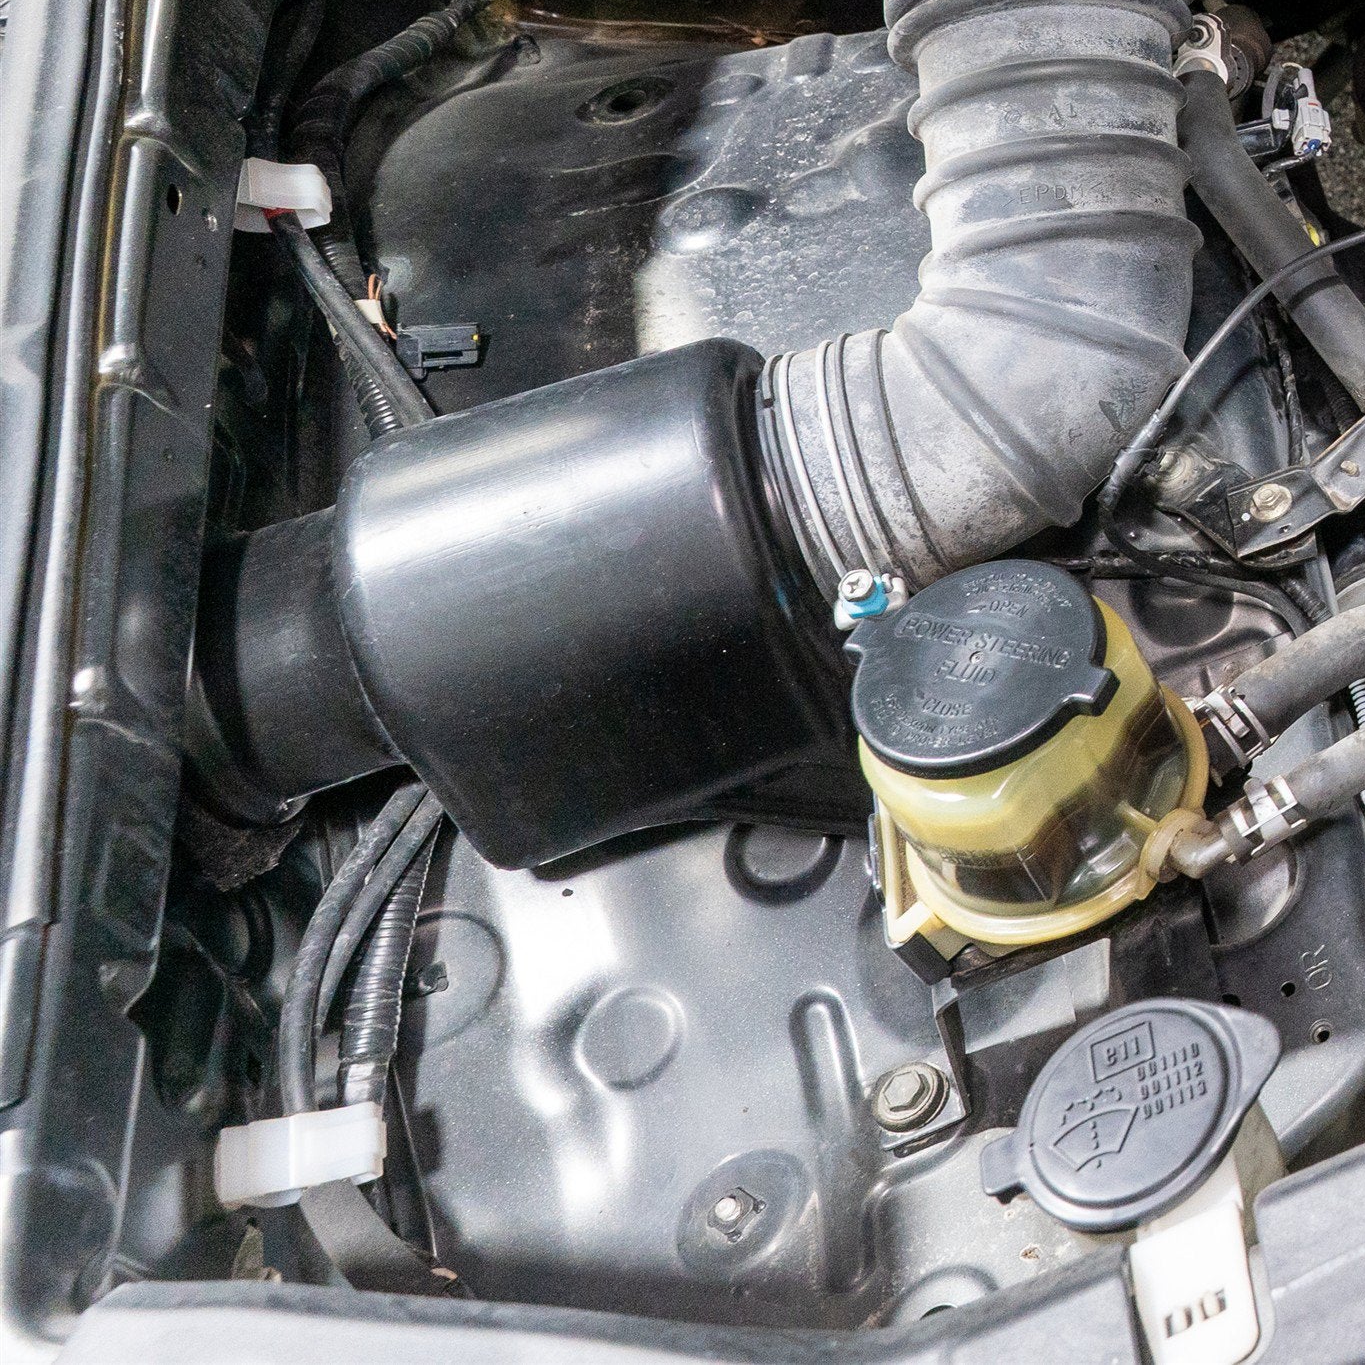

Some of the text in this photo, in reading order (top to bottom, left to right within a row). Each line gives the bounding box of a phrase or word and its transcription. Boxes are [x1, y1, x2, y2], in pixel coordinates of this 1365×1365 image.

[988, 599, 1031, 618] OPEN
[901, 617, 1071, 669] POWER STEERING
[934, 659, 997, 686] FLUID
[922, 698, 974, 718] CLOSE
[1105, 1036, 1140, 1068] e11
[1141, 1060, 1203, 1101] 001112
